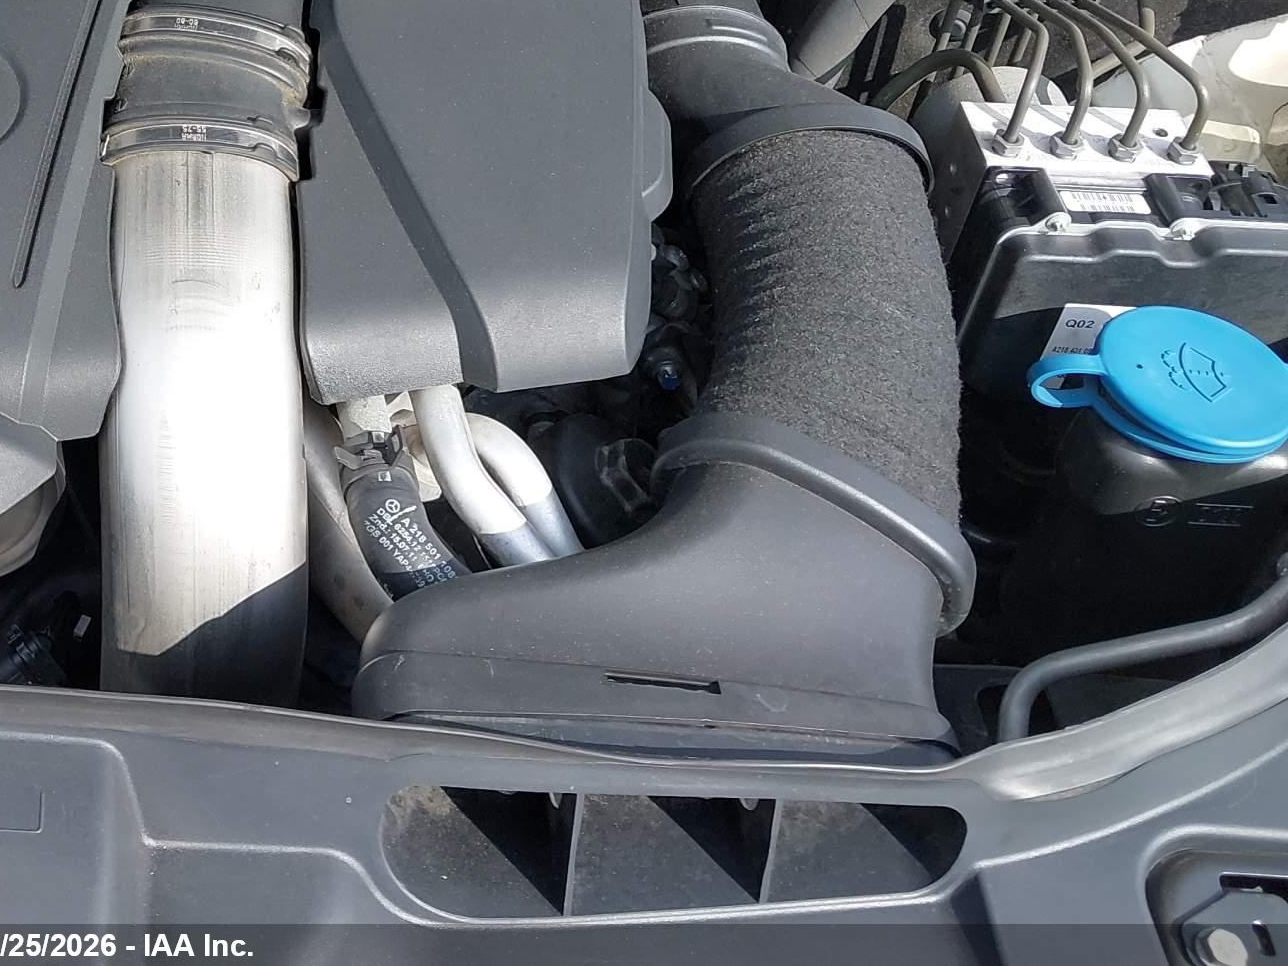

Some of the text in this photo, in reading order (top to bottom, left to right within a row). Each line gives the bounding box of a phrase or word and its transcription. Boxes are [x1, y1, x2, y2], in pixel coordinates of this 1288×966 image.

[1065, 319, 1095, 329] Q02
[379, 536, 394, 551] 001
[401, 517, 410, 527] A
[409, 522, 427, 543] 218
[425, 542, 442, 560] 501
